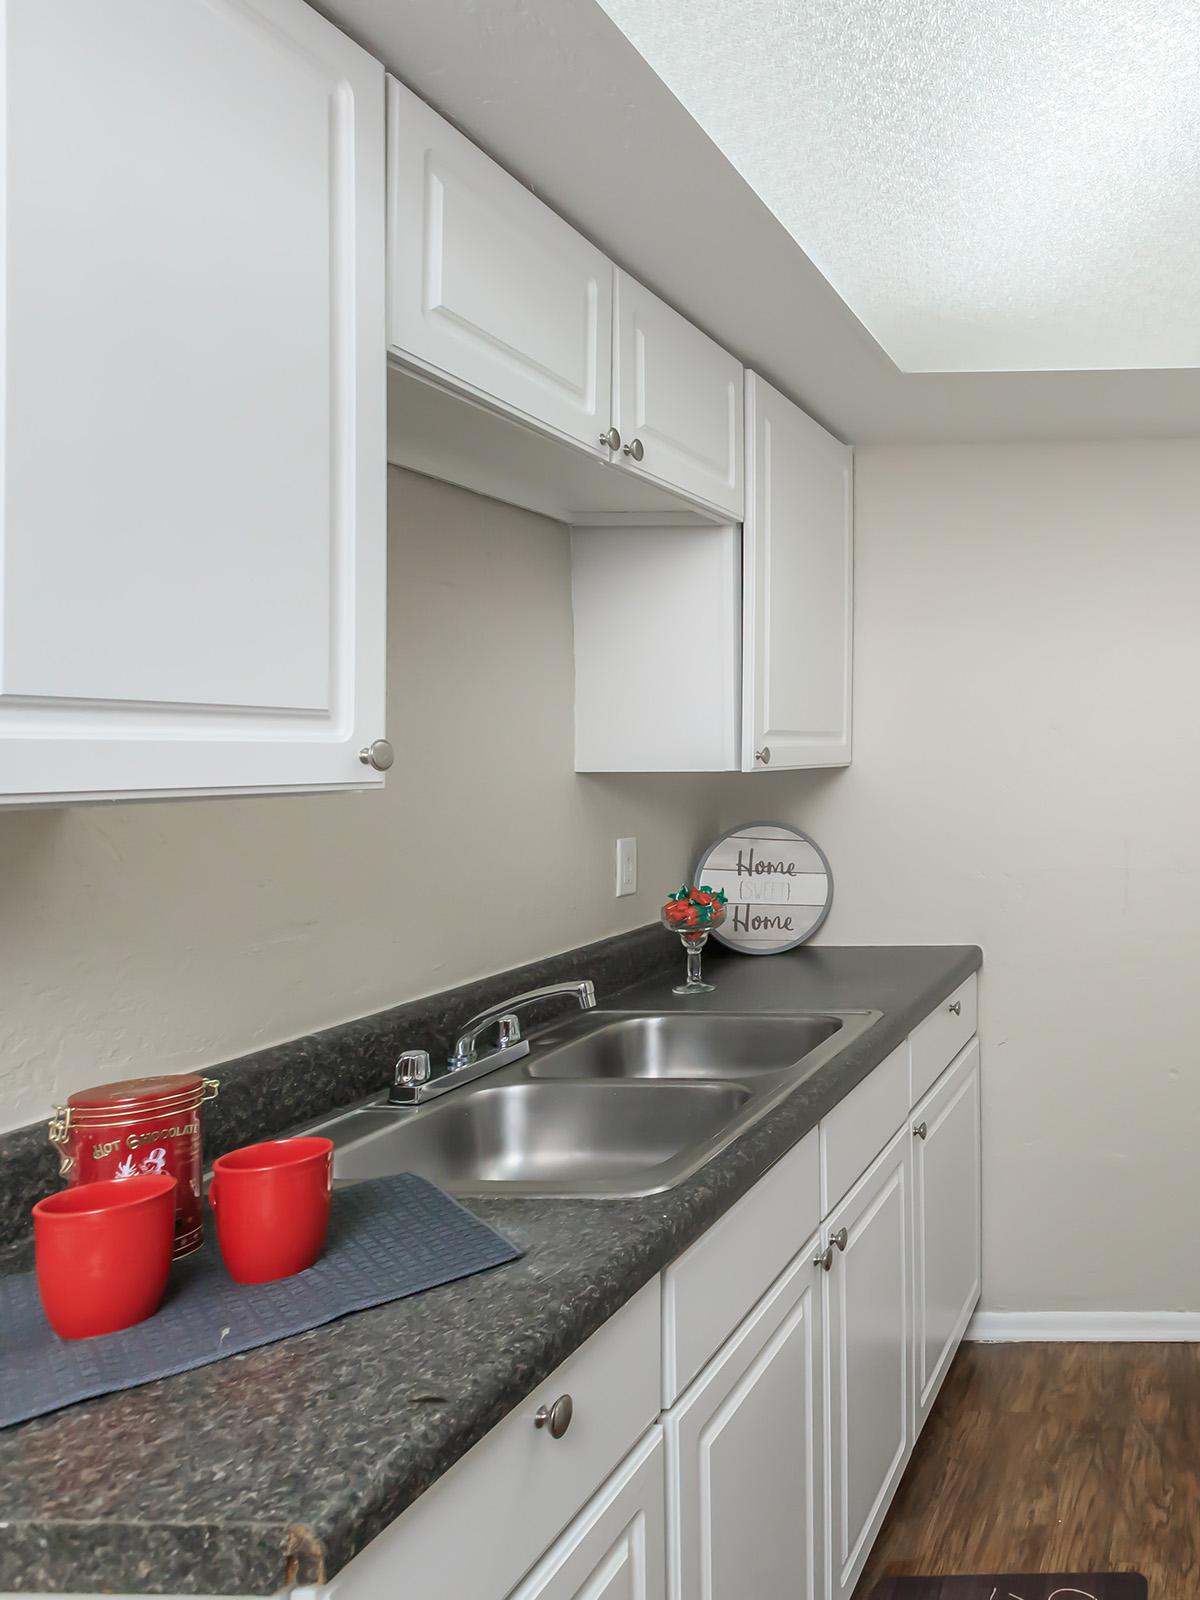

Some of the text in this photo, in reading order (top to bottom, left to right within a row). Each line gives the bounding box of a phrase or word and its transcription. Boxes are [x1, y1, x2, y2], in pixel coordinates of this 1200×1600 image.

[736, 847, 798, 877] Home
[732, 903, 794, 932] Home
[92, 1140, 121, 1160] HOT
